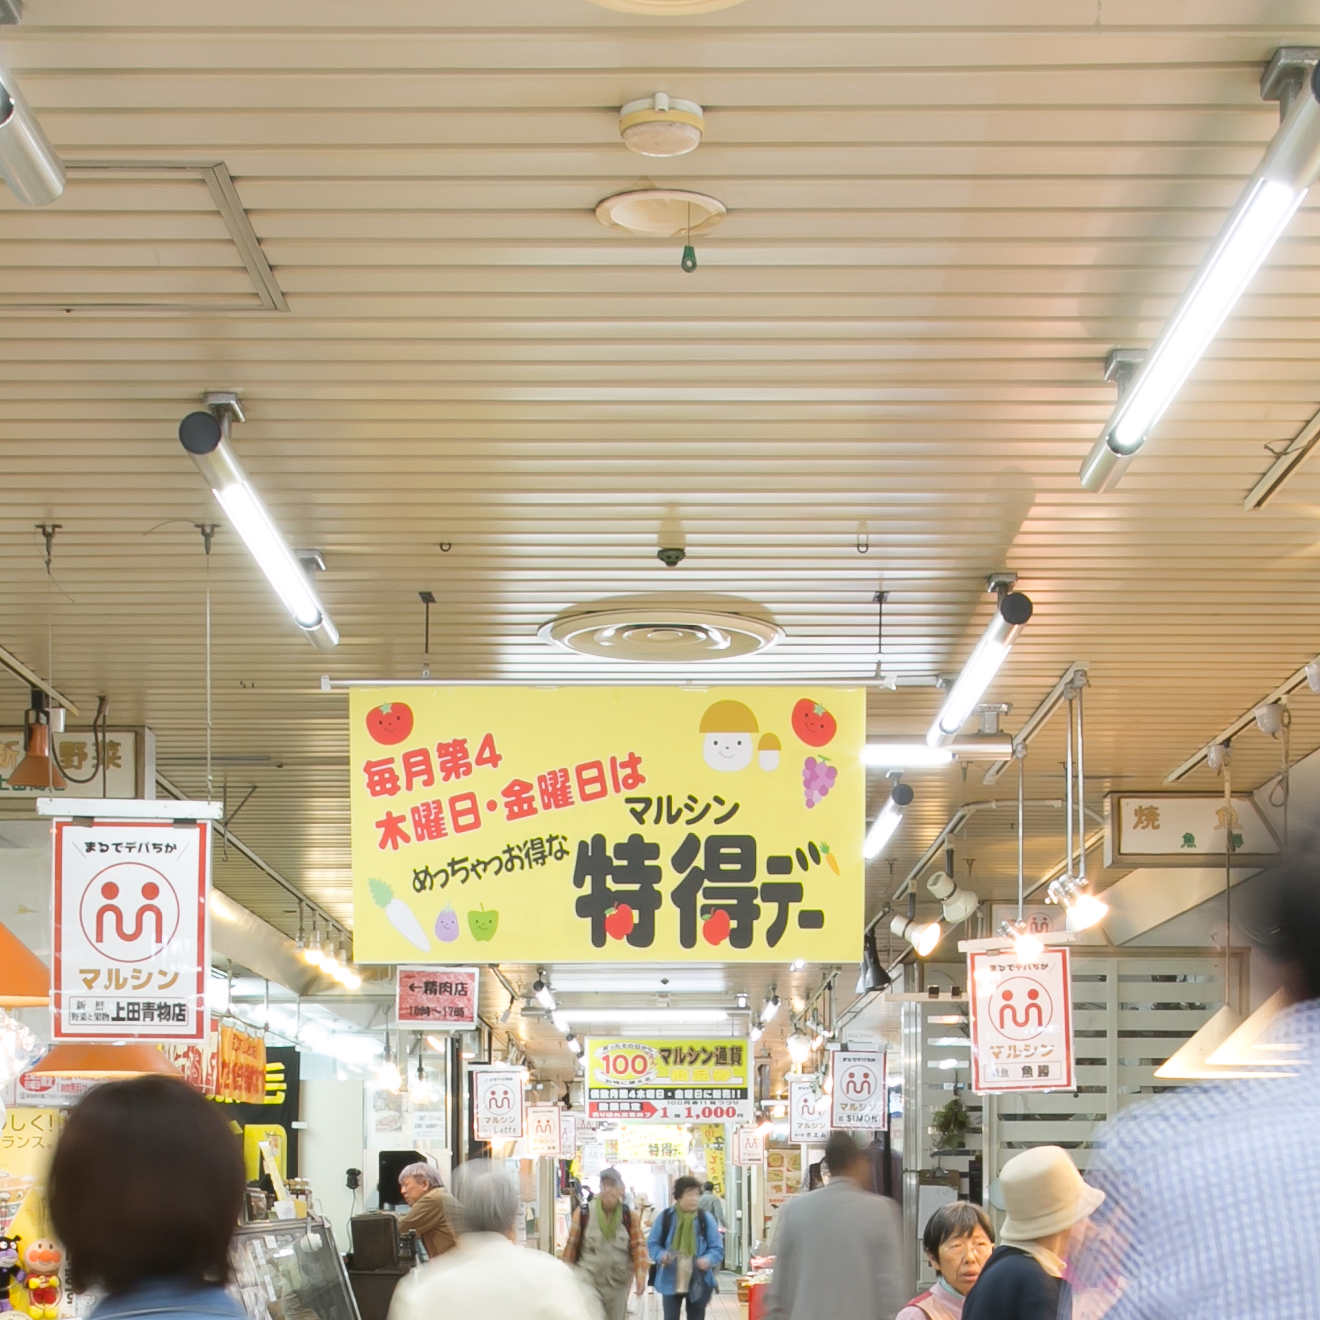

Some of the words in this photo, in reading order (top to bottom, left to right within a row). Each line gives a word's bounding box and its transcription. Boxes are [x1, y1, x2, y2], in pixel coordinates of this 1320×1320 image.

[363, 732, 503, 798] 毎月第4
[374, 751, 647, 851] 木曜日・金曜日は
[624, 794, 741, 827] マルシン
[1132, 804, 1245, 832] 焼魚
[84, 841, 178, 854] まるでデパちか
[572, 832, 826, 949] 特得デー
[78, 968, 180, 991] マルシン
[423, 980, 468, 996] 精肉店
[70, 1011, 110, 1022] 野菜と果物
[111, 1000, 188, 1023] 上田青物店
[659, 1045, 743, 1067] マルシン通貨
[989, 1043, 1056, 1060] マルシン
[601, 1054, 648, 1076] 100
[484, 1116, 516, 1125] マルシン
[493, 1125, 517, 1134] Latte
[796, 1122, 826, 1130] マルシン
[846, 1114, 879, 1124] SIMON
